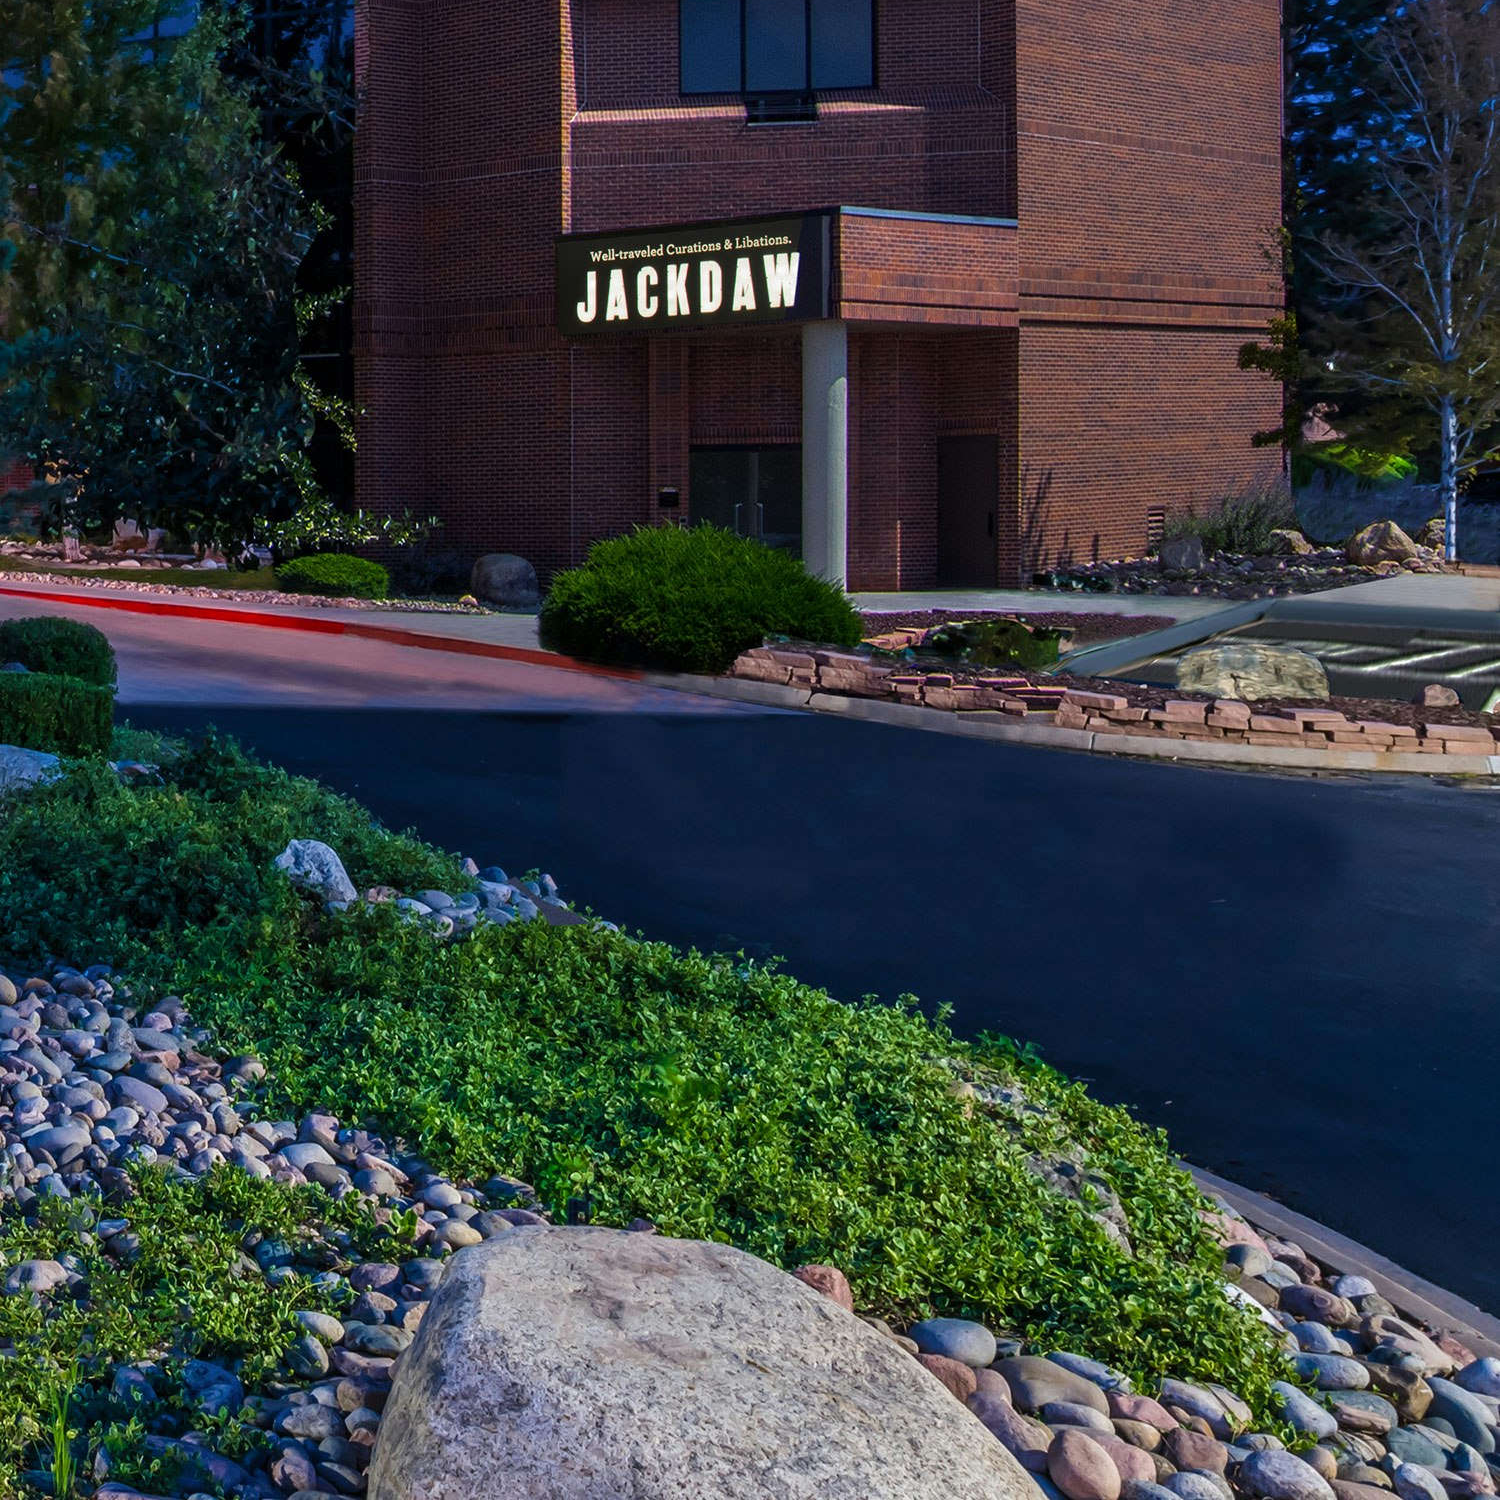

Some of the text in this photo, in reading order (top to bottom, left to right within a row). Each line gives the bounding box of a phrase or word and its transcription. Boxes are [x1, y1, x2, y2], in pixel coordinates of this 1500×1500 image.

[590, 235, 792, 262] Well-traveled Curations & Libations.
[576, 252, 800, 323] JACKDAW
